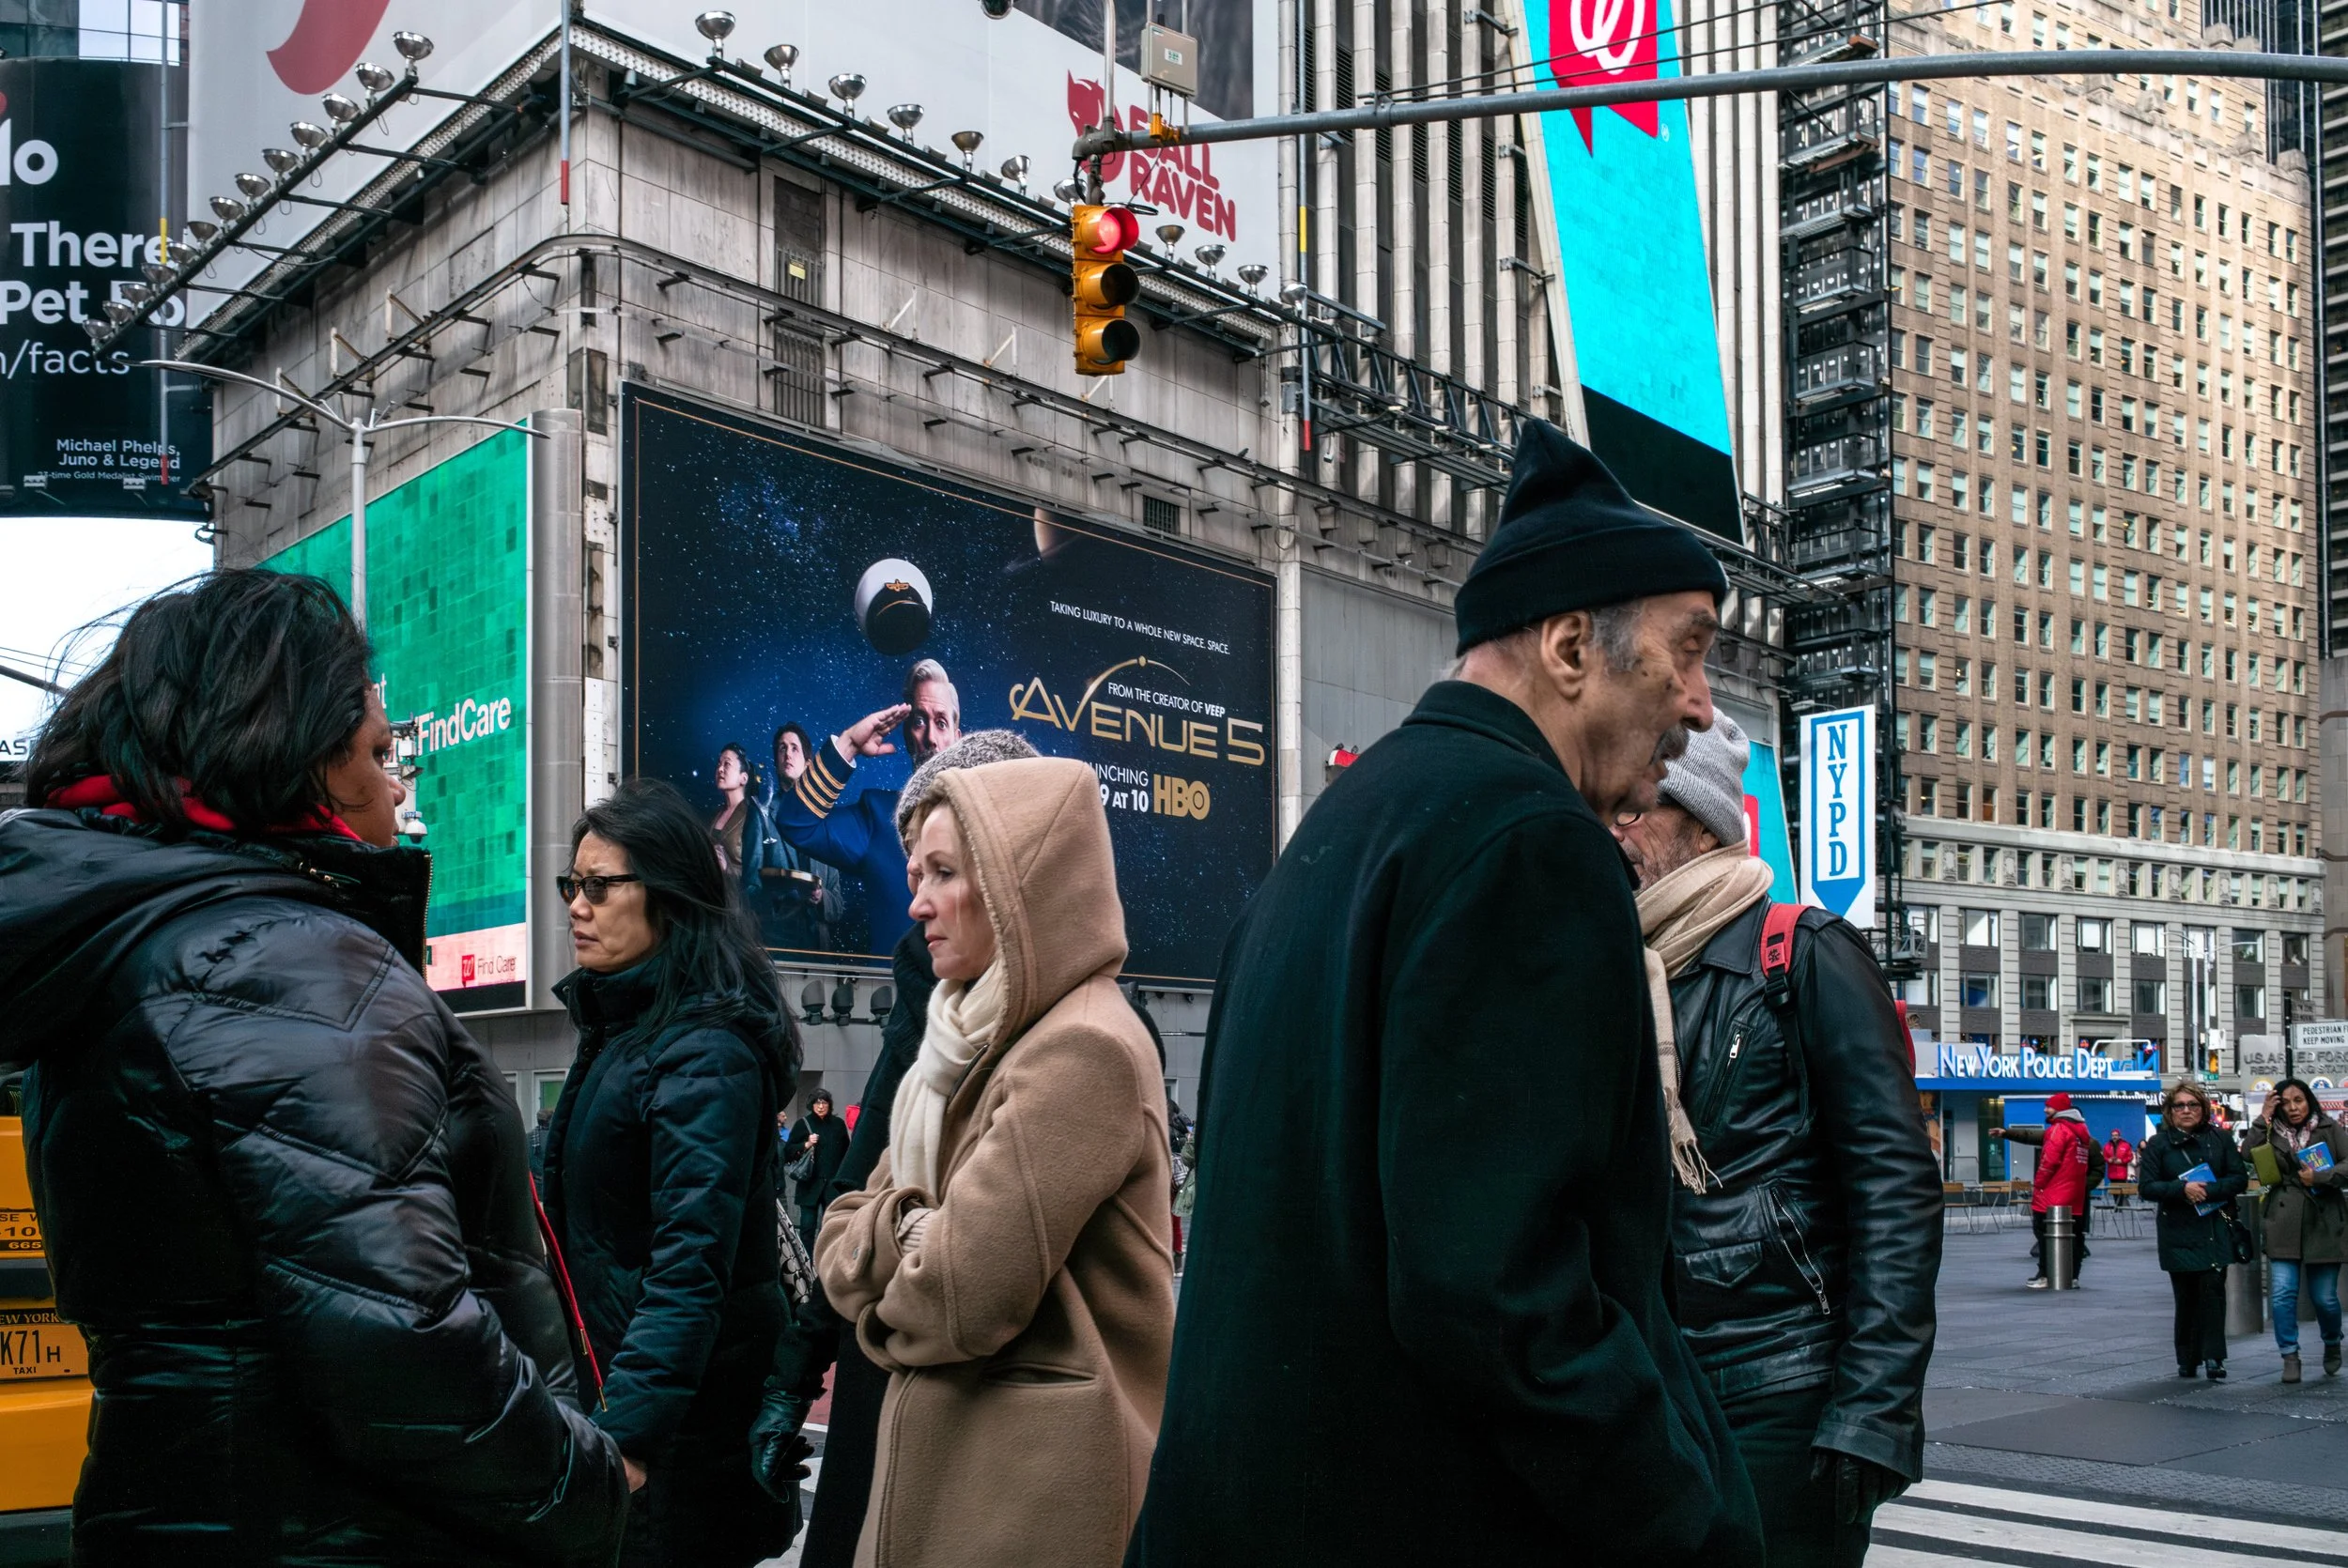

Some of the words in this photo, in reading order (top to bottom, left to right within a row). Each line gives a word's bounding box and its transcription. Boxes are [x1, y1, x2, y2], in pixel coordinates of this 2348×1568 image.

[1130, 152, 1236, 242] RÄVEN
[56, 438, 116, 453] Michael
[58, 453, 98, 466] Juno
[102, 454, 115, 467] &
[1050, 601, 1081, 618] TAKING
[1083, 609, 1112, 625] LUXURY
[1114, 616, 1125, 629] TO
[1127, 621, 1133, 631] A
[1135, 622, 1162, 638] WHOLE
[1164, 629, 1182, 643] NEW
[1182, 634, 1206, 649] SPACE.
[1208, 639, 1230, 655] SPACE.
[1108, 682, 1134, 699] FROM
[1135, 687, 1151, 703] THE
[1152, 691, 1190, 711] CREATOR
[1191, 700, 1204, 714] OF
[1204, 703, 1226, 717] VEEP
[418, 697, 512, 756] FindCare
[1009, 676, 1218, 759] AVENUE
[1227, 717, 1265, 766] 5
[1091, 762, 1149, 787] NCHING
[1112, 792, 1129, 809] AT
[1131, 791, 1149, 813] 10
[1153, 774, 1211, 820] HBO
[1828, 724, 1847, 877] NYPD
[2303, 1026, 2341, 1035] PEDESTRIAN
[2303, 1037, 2319, 1045] KEEP
[23, 1313, 61, 1323] YORK
